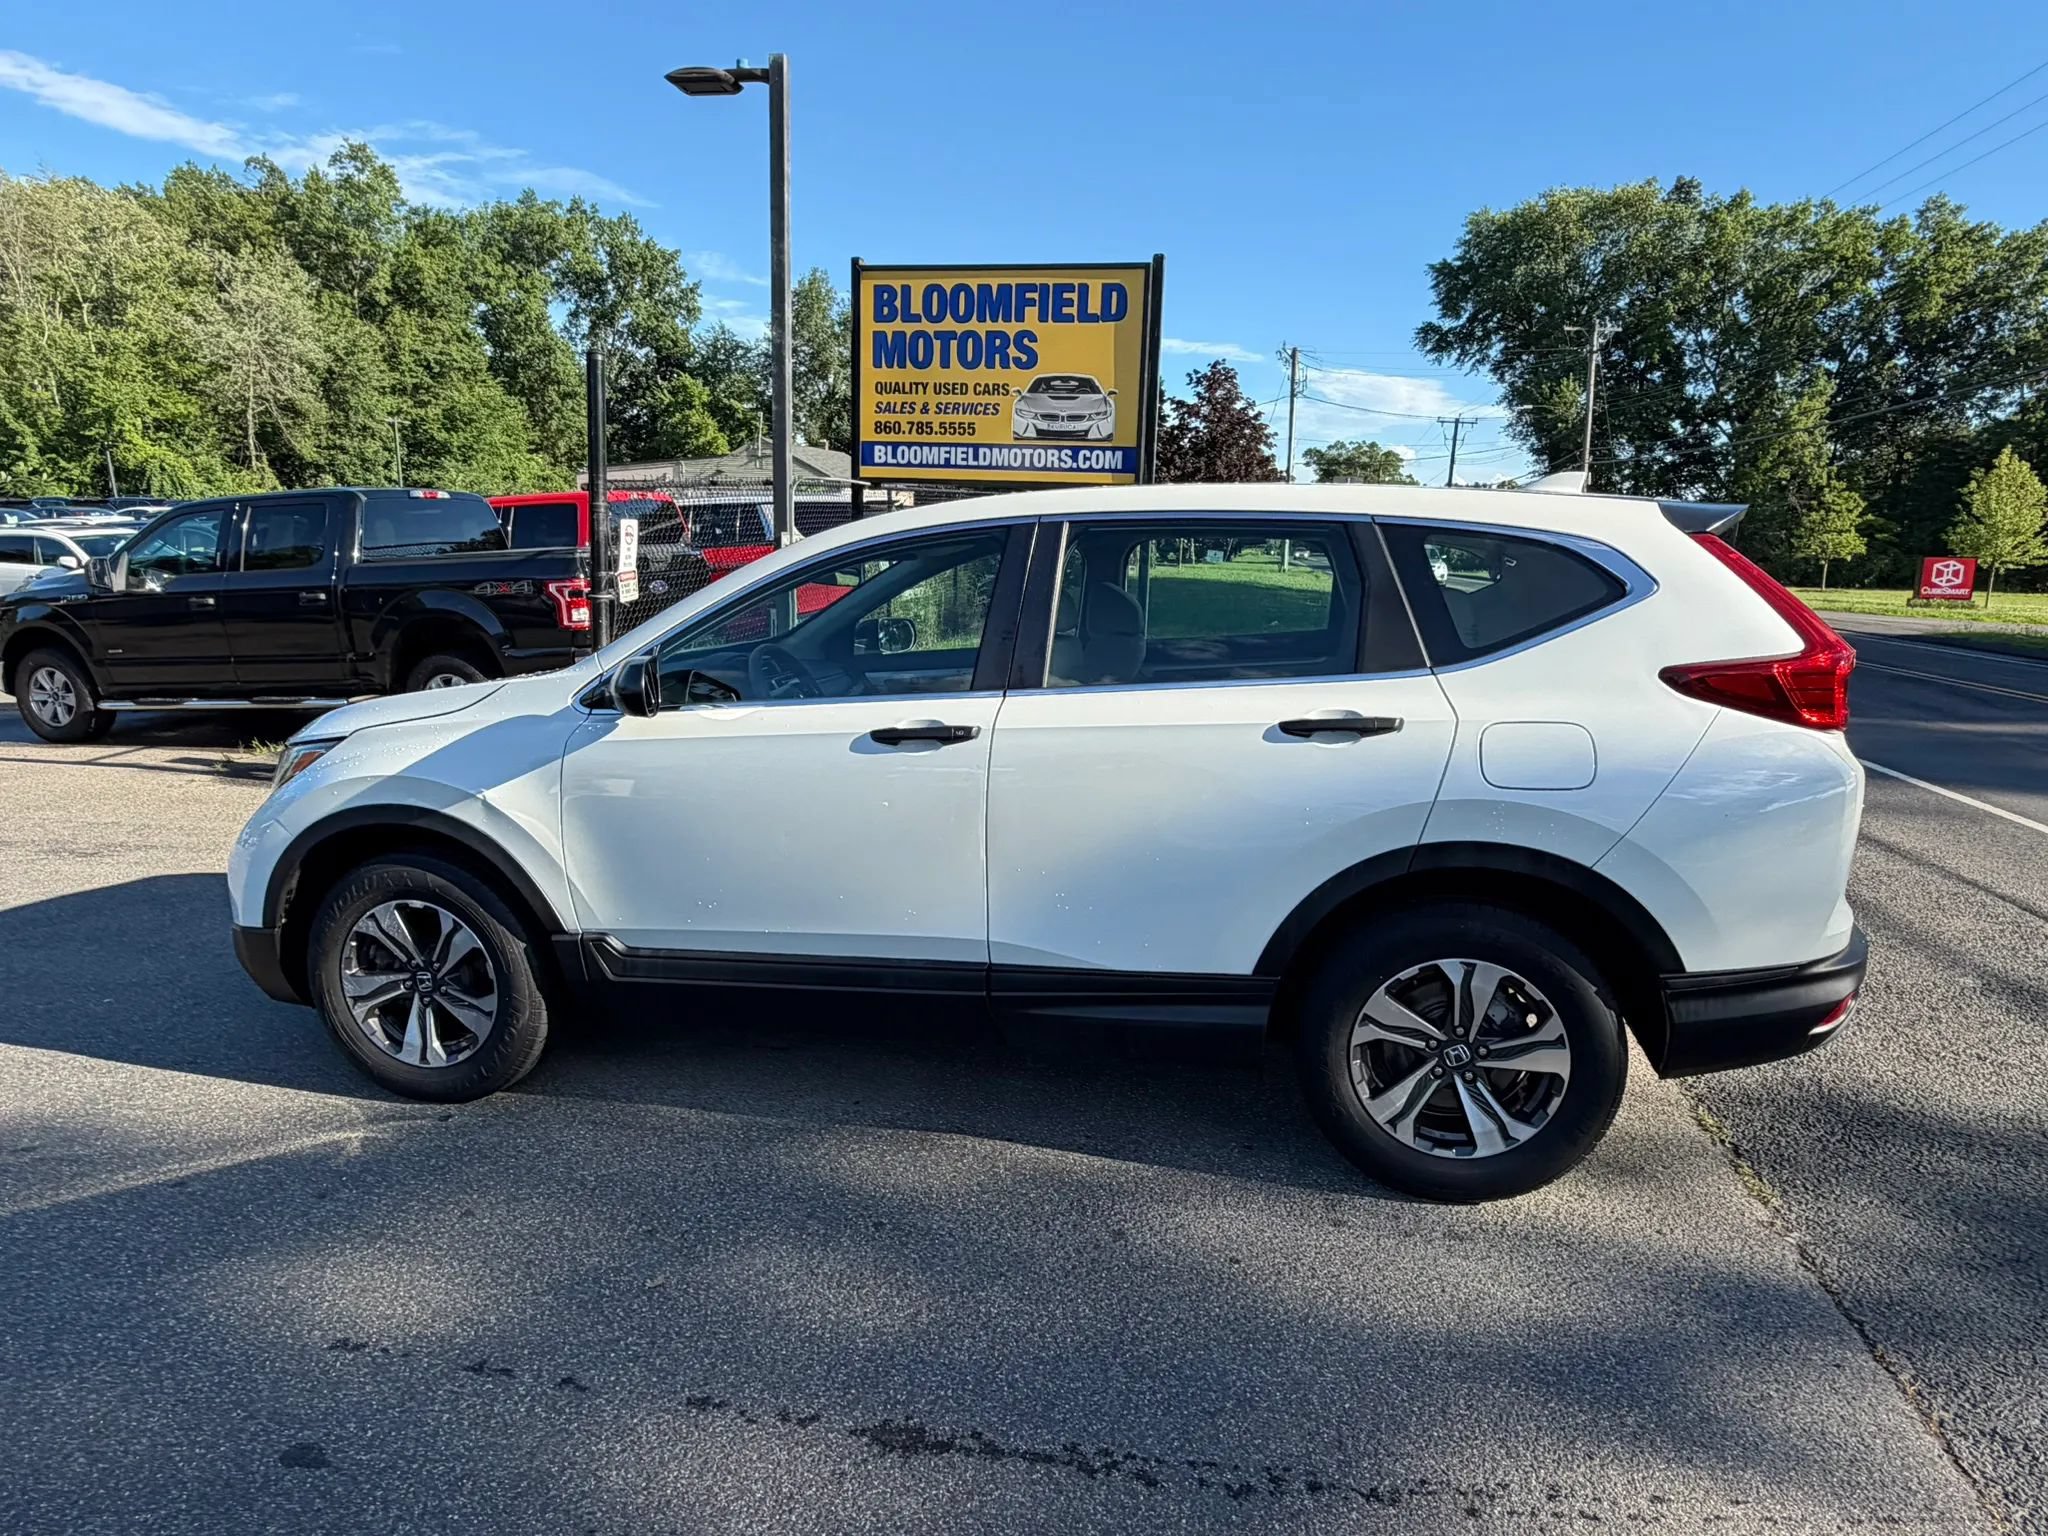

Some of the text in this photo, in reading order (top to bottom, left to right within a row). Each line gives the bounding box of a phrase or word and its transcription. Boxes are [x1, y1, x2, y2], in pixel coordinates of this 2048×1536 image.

[872, 282, 1129, 324] BLOOMFIELD
[872, 329, 1039, 370] MOTORS
[874, 381, 929, 396] QUALITY
[933, 382, 969, 396] USED
[874, 401, 1001, 416] SALES & SERVICES
[874, 420, 977, 436] 860.785.5555
[873, 445, 1123, 471] BLOOMFIELDMOTORS.COM
